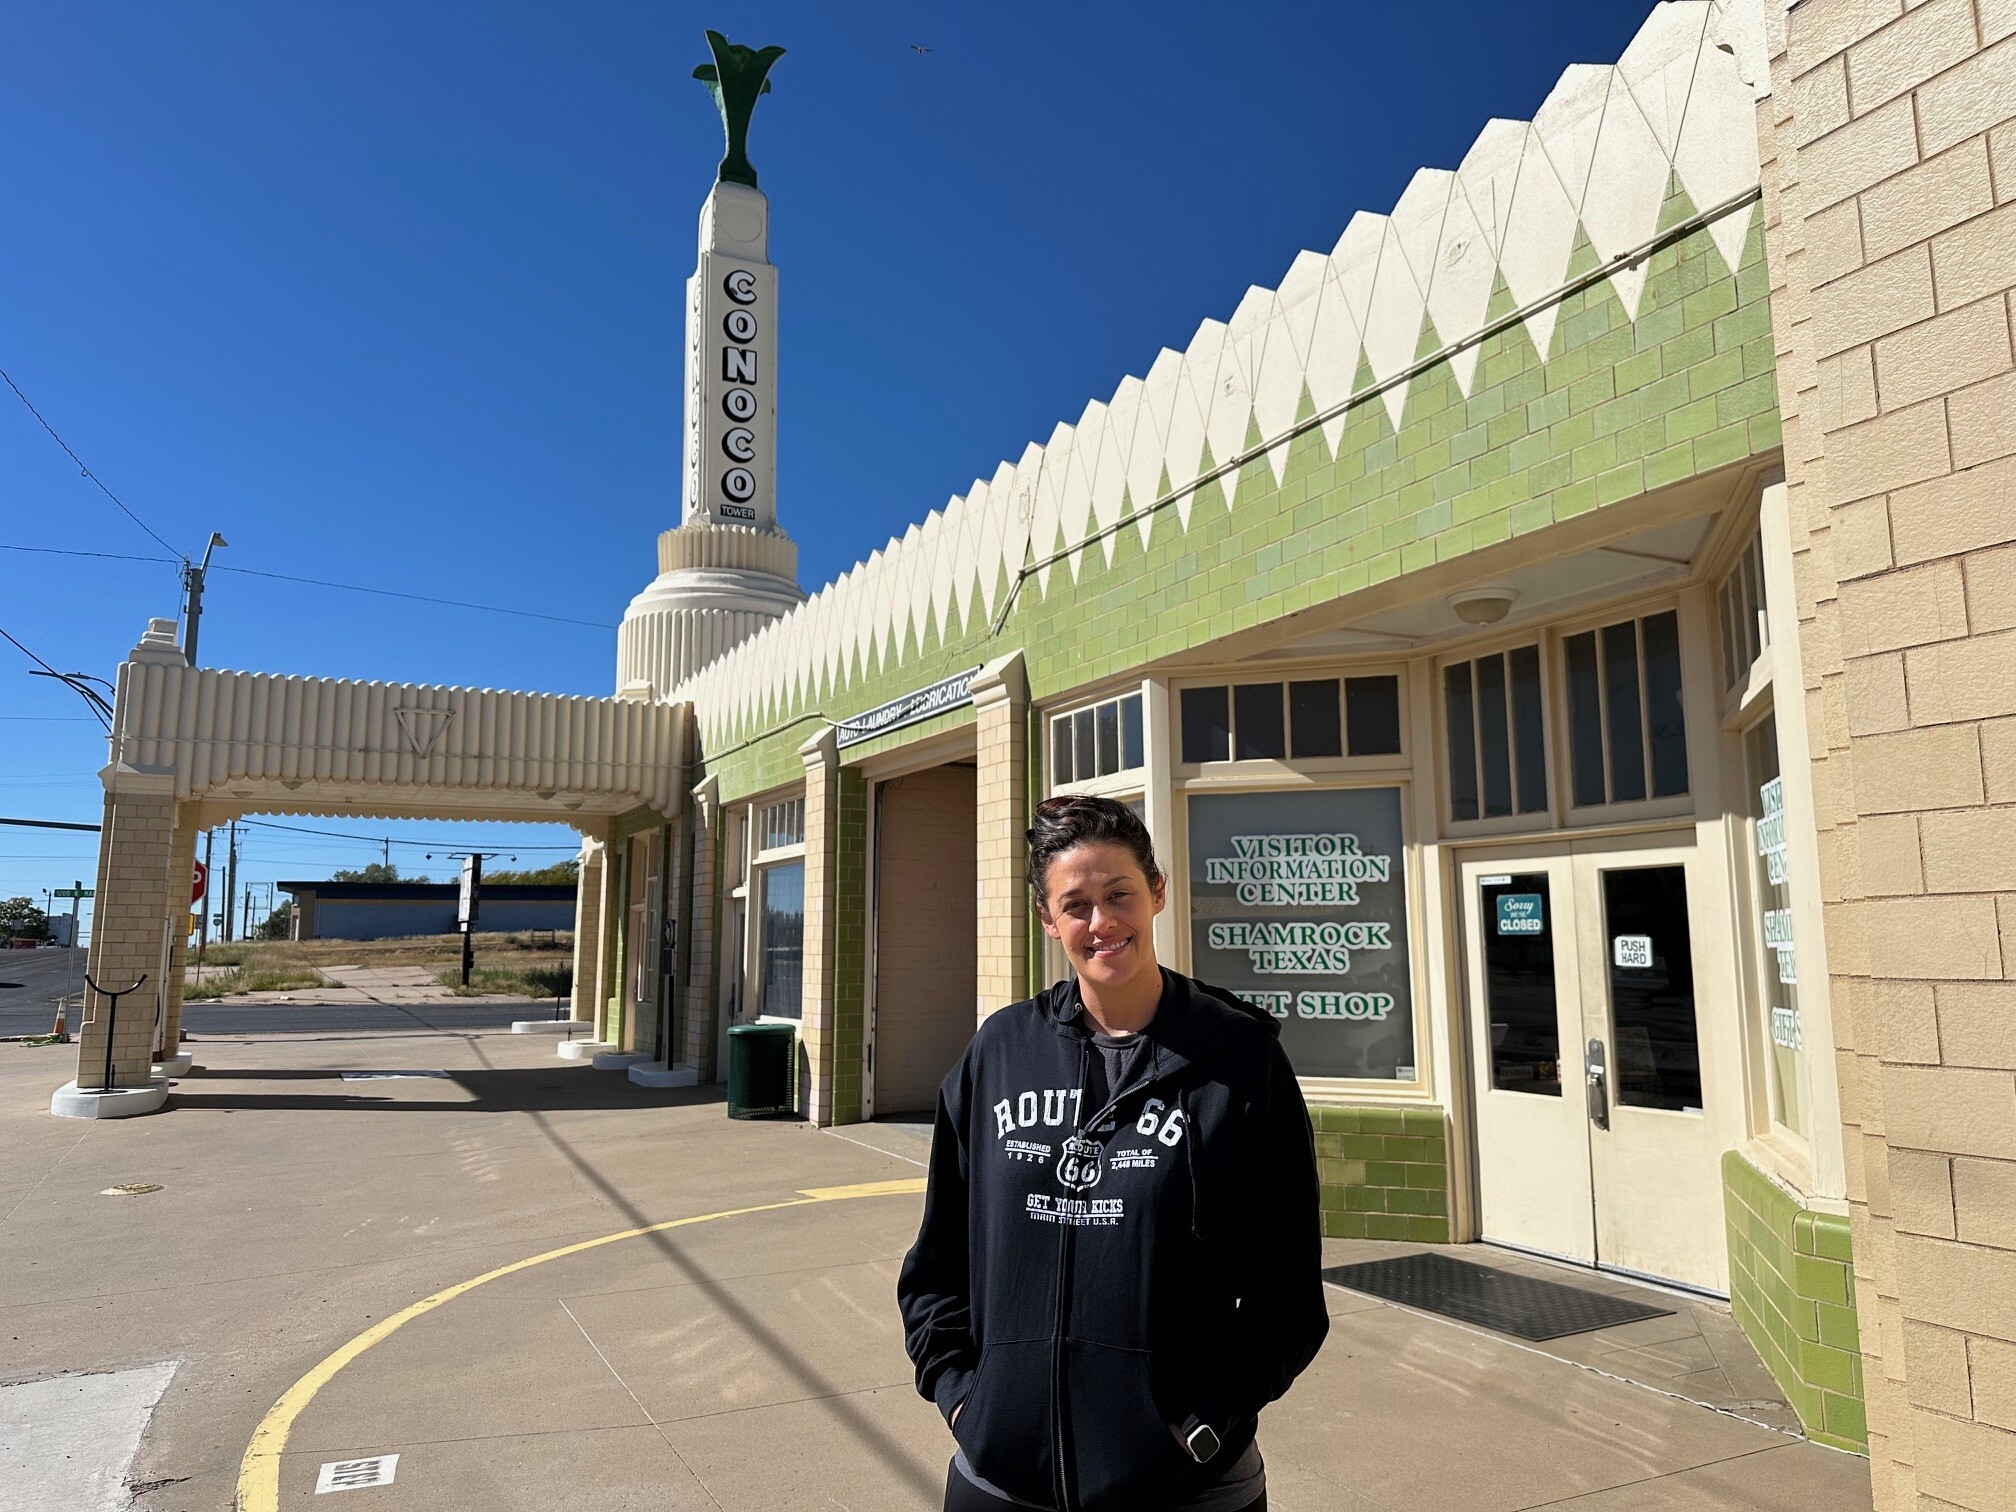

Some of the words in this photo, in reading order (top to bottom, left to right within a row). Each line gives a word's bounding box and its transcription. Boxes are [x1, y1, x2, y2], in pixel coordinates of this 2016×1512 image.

[721, 269, 757, 504] CONOCO
[721, 506, 755, 519] TOWER
[839, 719, 861, 742] AUTO
[863, 704, 903, 733] LAUNDRY
[910, 674, 976, 715] LUBRICATIO
[1233, 836, 1359, 858] VISITOR
[1209, 858, 1387, 881] INFORMATION
[1239, 881, 1356, 903] CENTER
[1504, 898, 1534, 914] Sorry
[1211, 925, 1388, 946] SHAMROCK
[1500, 919, 1541, 931] CLOSED
[1621, 940, 1646, 952] PUSH
[1252, 950, 1347, 971] TEXAS
[1621, 953, 1647, 964] HARD
[1301, 994, 1390, 1016] SHOP
[1136, 1098, 1191, 1147] 66
[1005, 1139, 1051, 1153] ESTABLISHED
[1116, 1150, 1140, 1158] TOTAL
[1064, 1157, 1096, 1182] 66
[1132, 1159, 1156, 1168] MILES
[1026, 1193, 1051, 1209] GET
[1091, 1198, 1124, 1214] KICKS
[1092, 1217, 1119, 1226] U.S.A.
